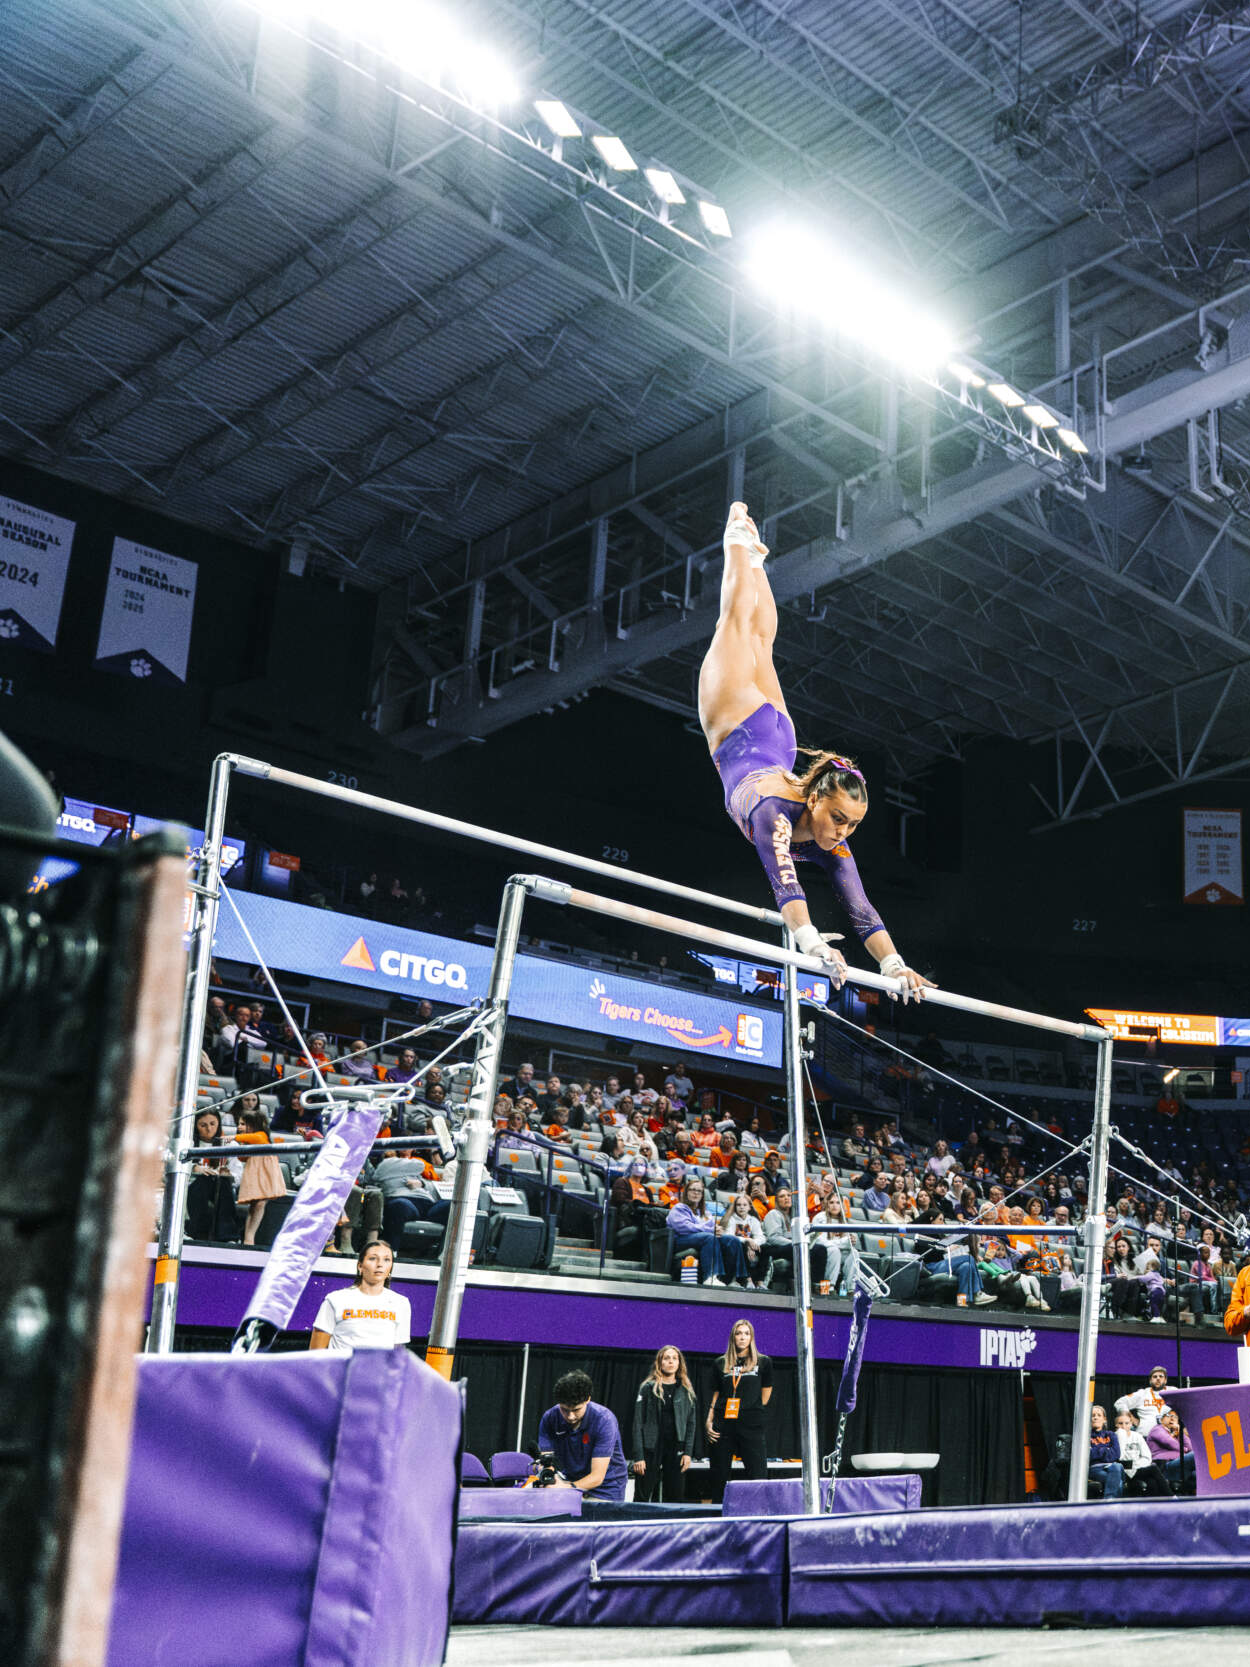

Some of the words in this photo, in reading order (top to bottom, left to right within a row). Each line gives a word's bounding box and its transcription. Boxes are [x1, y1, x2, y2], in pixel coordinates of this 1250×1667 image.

[2, 528, 47, 551] SEASON
[0, 561, 39, 587] 2024
[115, 566, 191, 599] TOURNAMENT
[140, 565, 168, 582] NCAA
[327, 770, 359, 790] 230
[601, 845, 630, 864] 229
[1072, 918, 1098, 932] 227
[380, 949, 467, 989] CITGO
[599, 997, 642, 1021] Tigers
[1114, 1013, 1172, 1027] WELCOME
[1161, 1028, 1215, 1043] COLISEUM
[343, 1309, 396, 1321] CLEMSON
